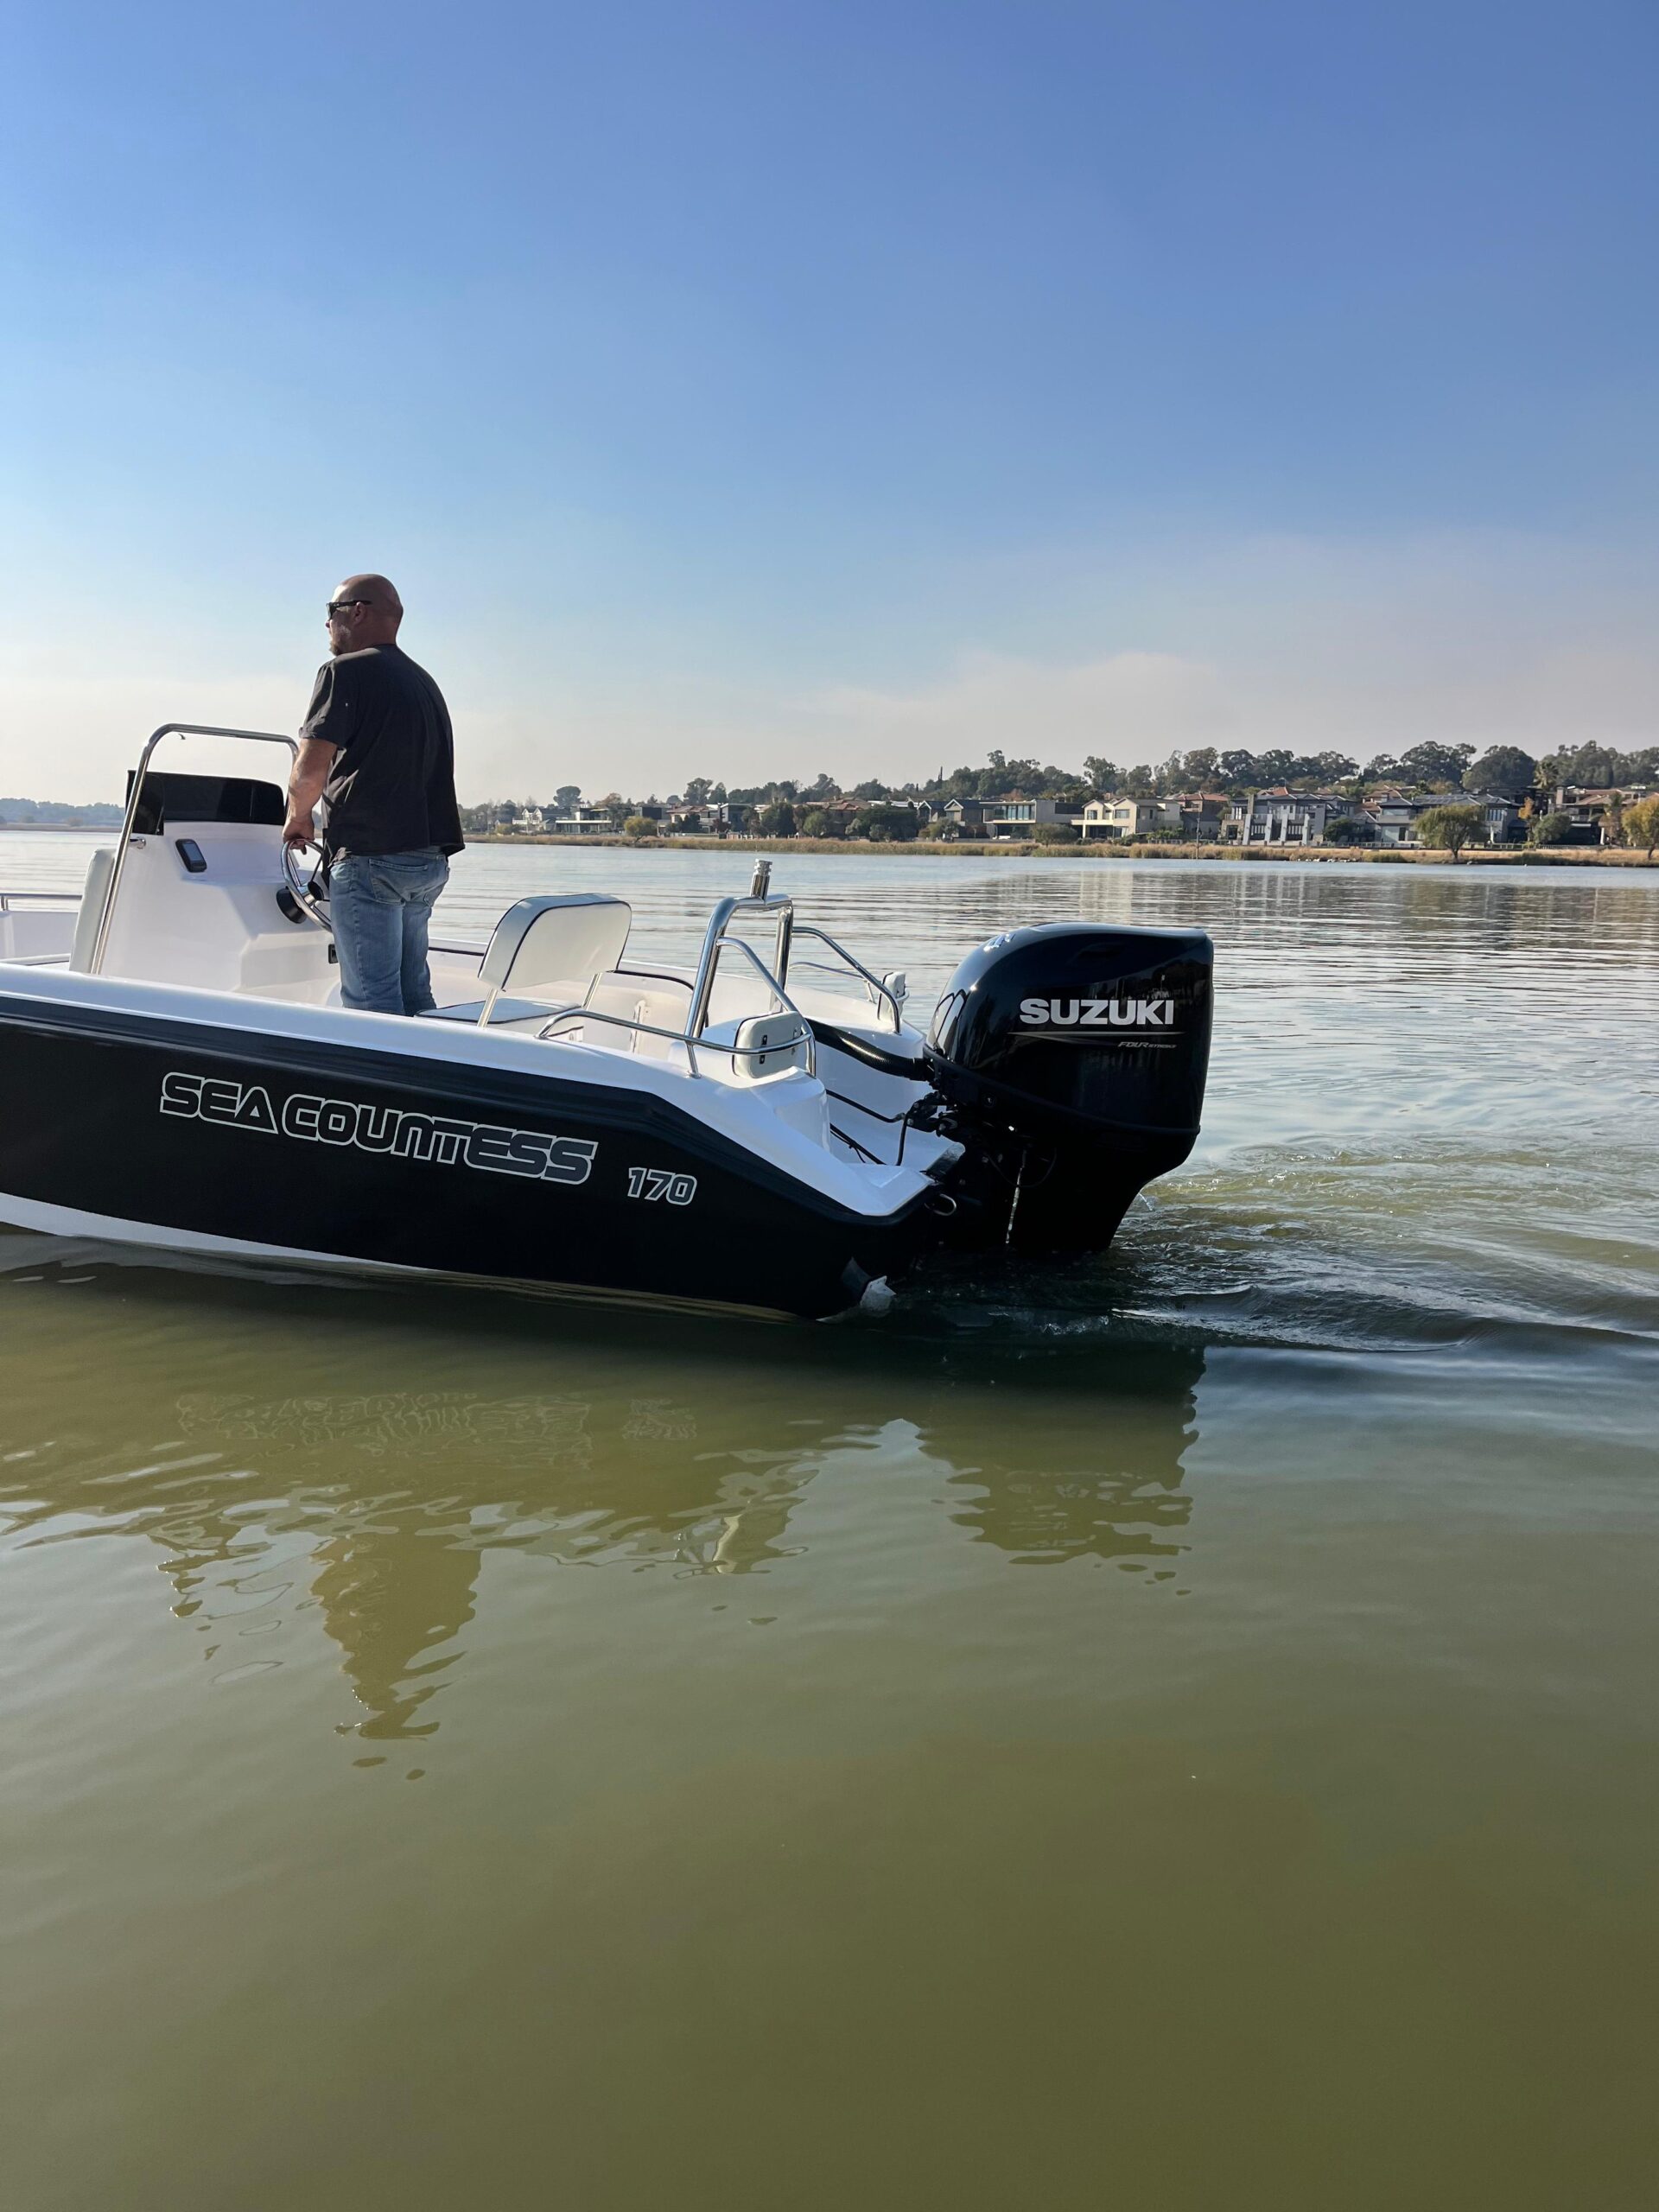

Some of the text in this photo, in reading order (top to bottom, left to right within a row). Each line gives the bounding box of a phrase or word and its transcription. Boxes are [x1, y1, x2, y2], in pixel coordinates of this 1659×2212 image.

[1020, 998, 1174, 1025] SUZUKI
[160, 1071, 598, 1185] SEA COUNTESS
[627, 1166, 697, 1205] 170
